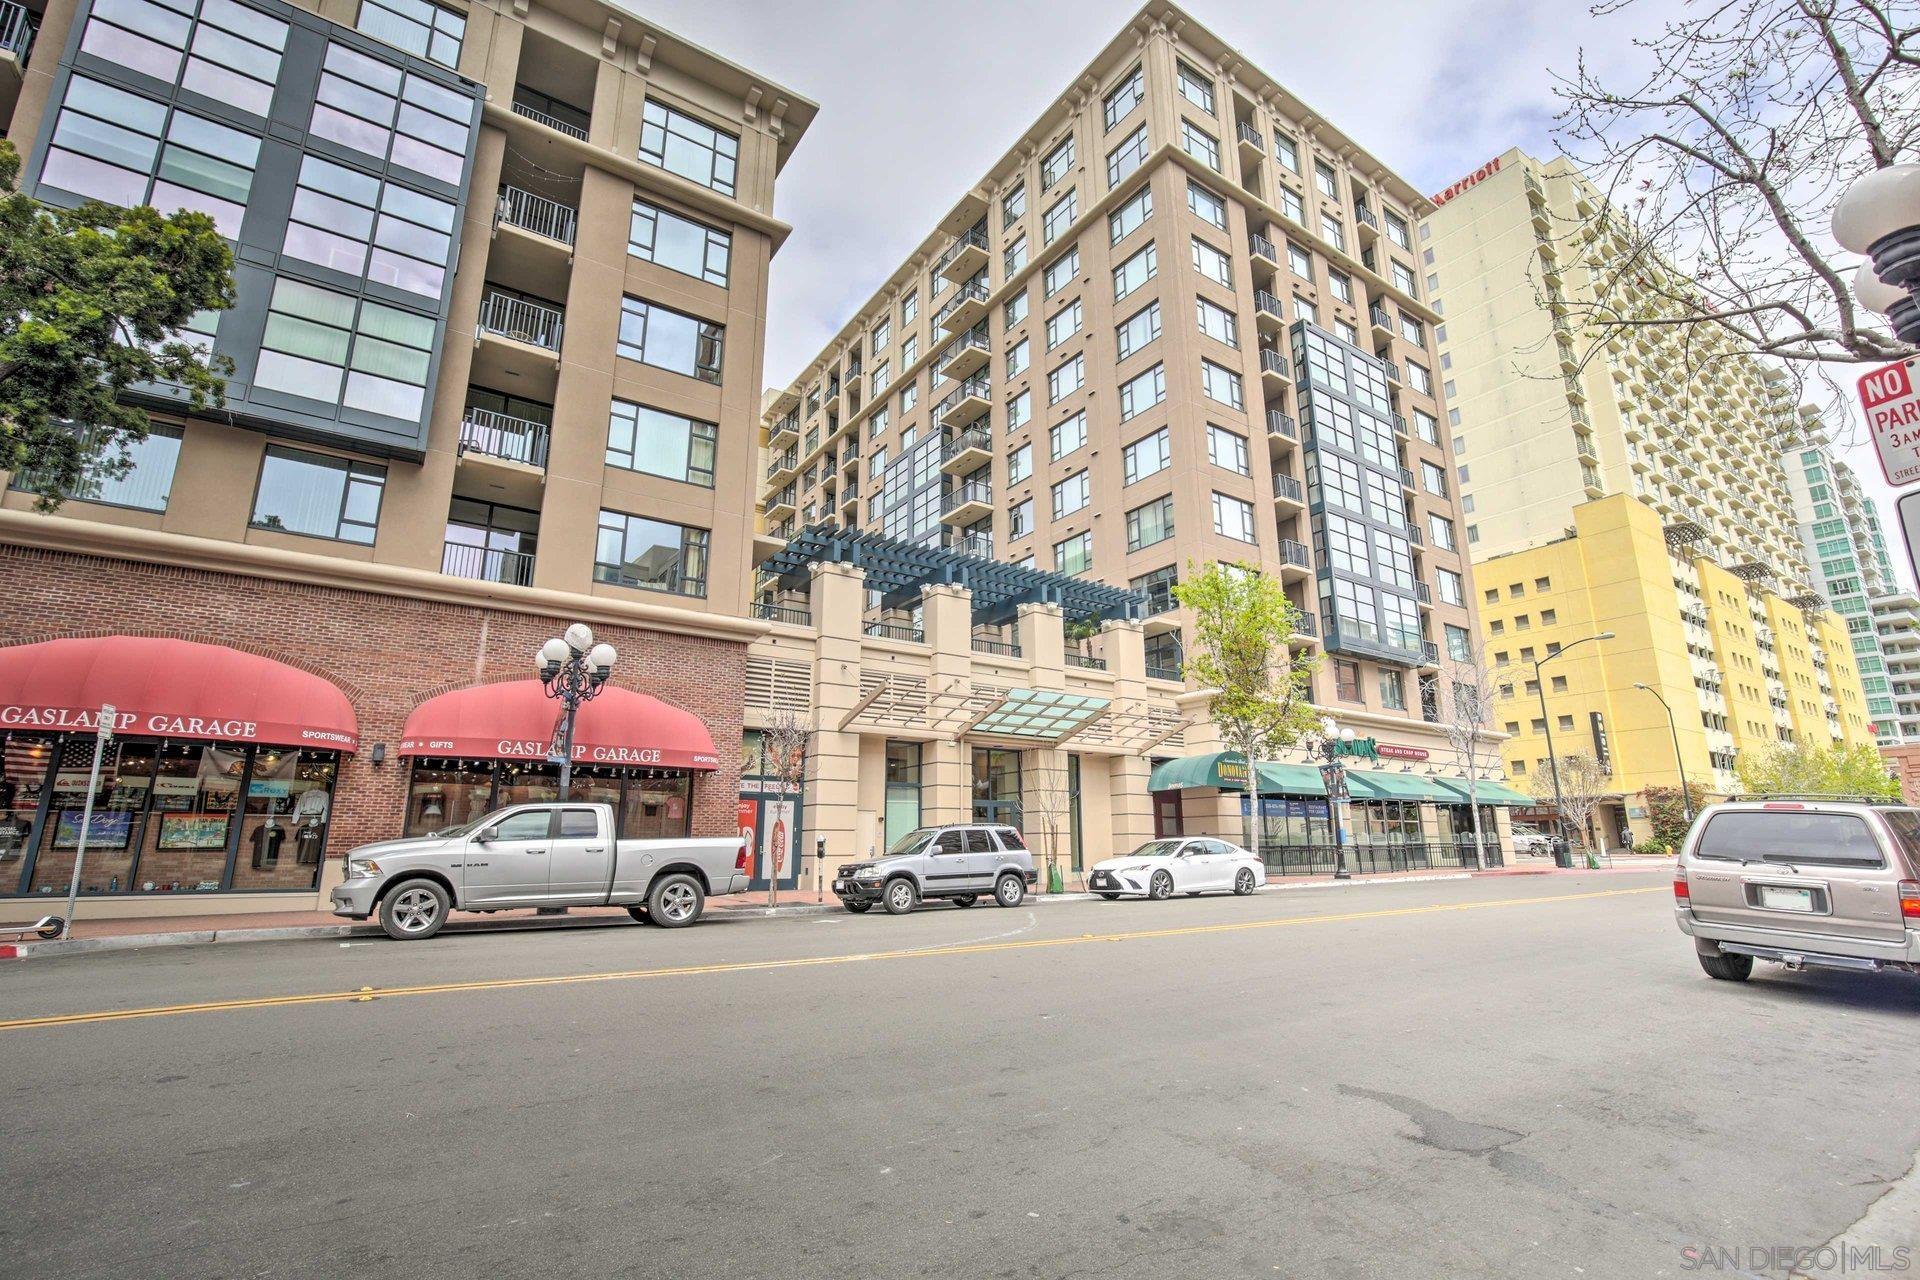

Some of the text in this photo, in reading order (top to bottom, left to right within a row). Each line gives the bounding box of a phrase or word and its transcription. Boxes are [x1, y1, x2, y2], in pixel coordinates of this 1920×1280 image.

[1865, 369, 1902, 402] NO
[1894, 464, 1920, 480] STREE
[147, 715, 256, 738] GARAGE
[302, 730, 351, 743] SPORTSWEAR
[430, 741, 453, 749] GIFTS
[593, 747, 661, 762] GARAGE
